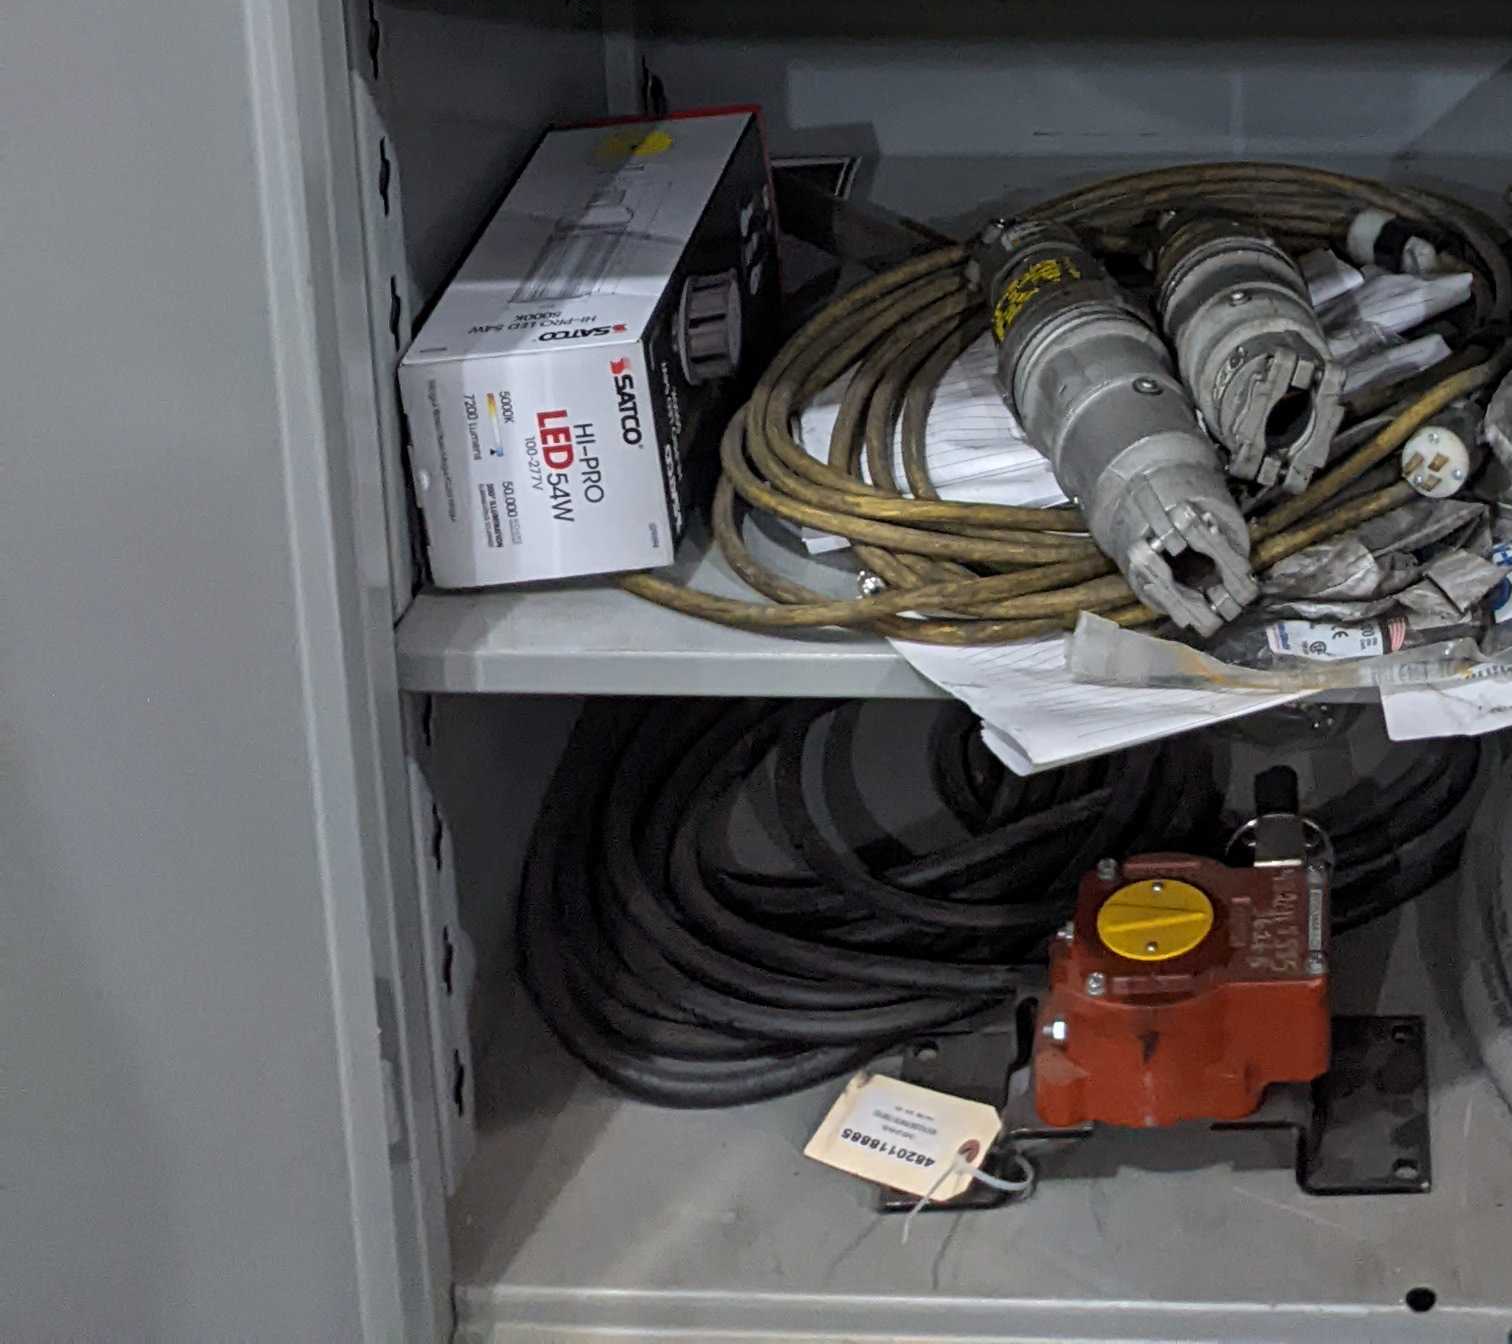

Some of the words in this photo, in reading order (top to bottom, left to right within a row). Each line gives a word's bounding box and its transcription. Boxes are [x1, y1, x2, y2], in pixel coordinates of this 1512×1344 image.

[507, 321, 536, 330] LED
[538, 325, 612, 342] SATCO
[464, 394, 478, 420] 7200
[499, 391, 514, 424] 5000K
[614, 374, 642, 446] SATCO
[524, 436, 543, 491] 100-277V
[536, 410, 574, 470] LED
[573, 423, 605, 504] HI-PRO
[546, 473, 574, 523] 54W
